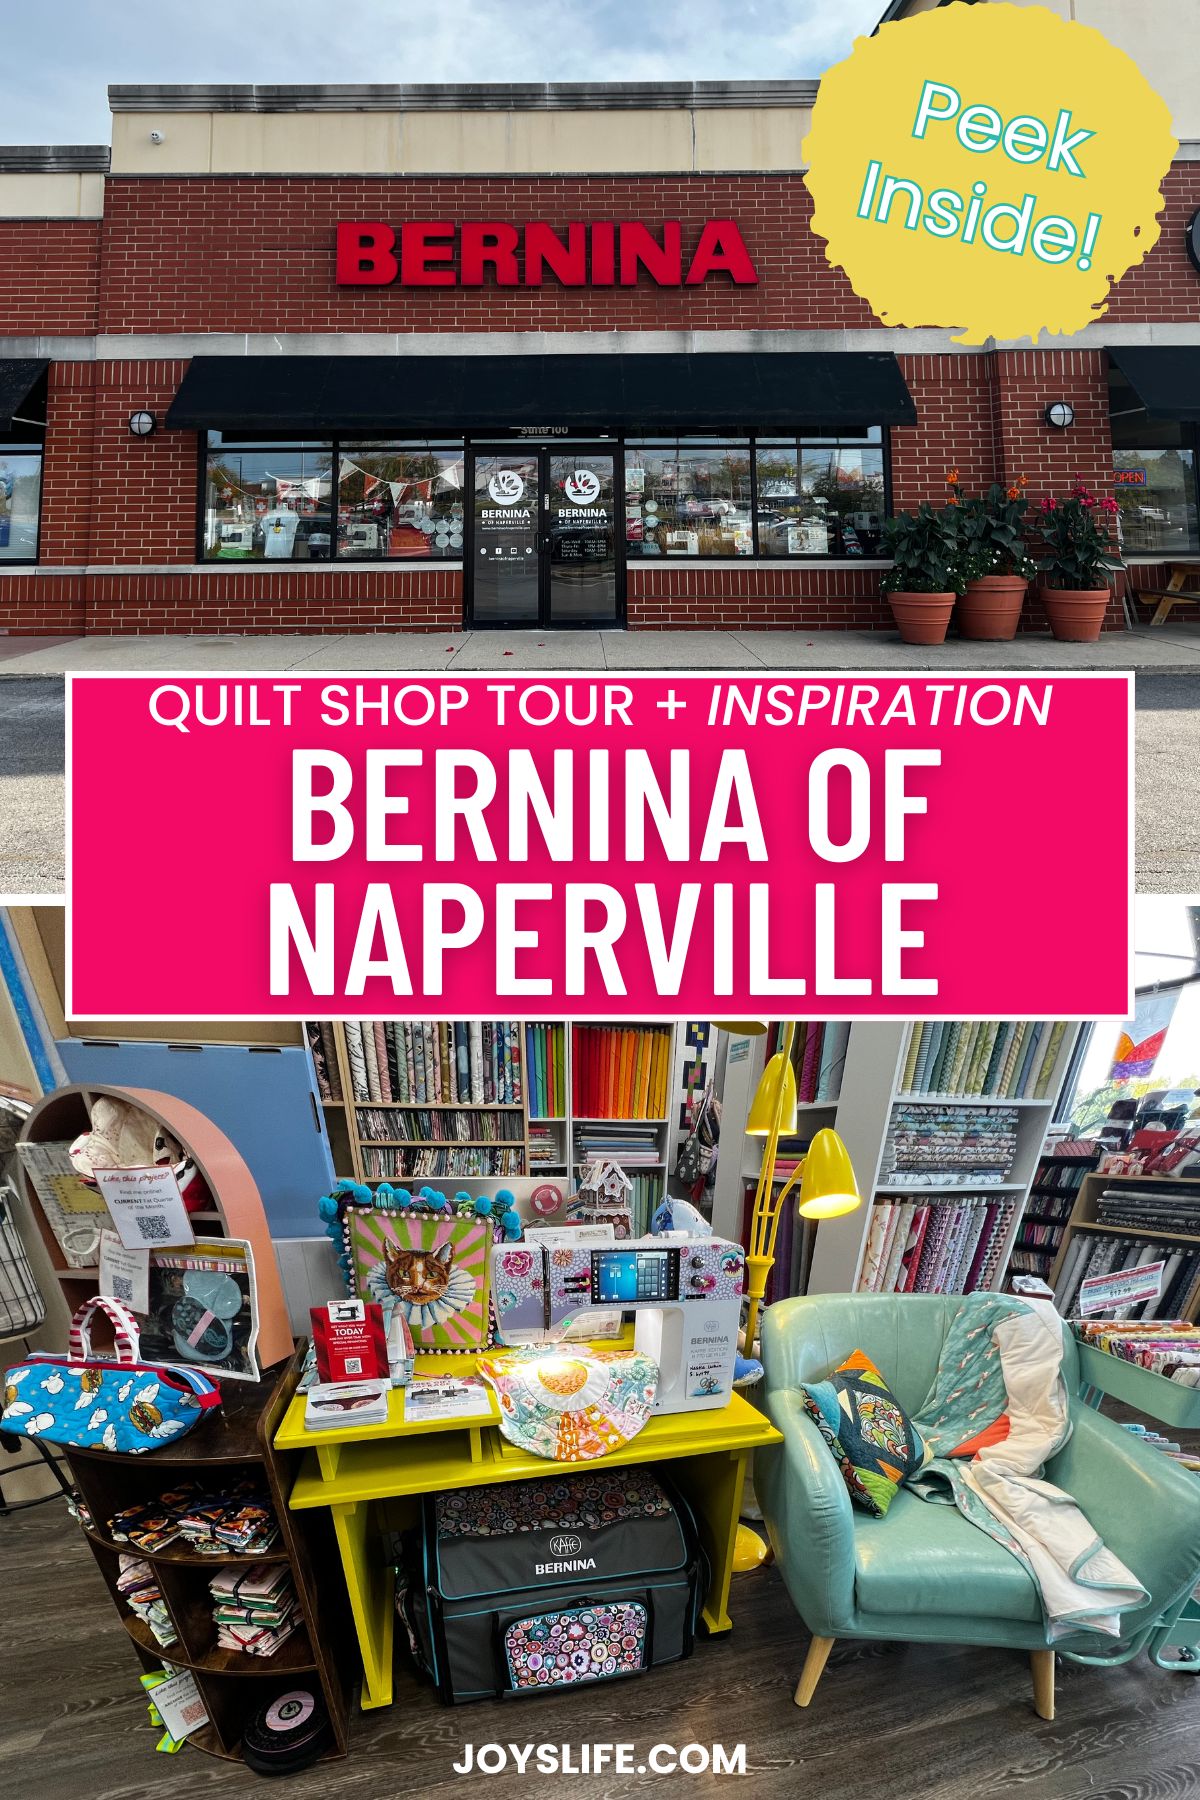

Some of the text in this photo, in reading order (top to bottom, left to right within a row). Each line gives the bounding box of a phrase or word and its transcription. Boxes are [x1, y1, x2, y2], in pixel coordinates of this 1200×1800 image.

[336, 219, 760, 287] BERNINA
[1113, 472, 1144, 483] OPEN
[482, 509, 530, 518] BERNINA
[558, 508, 607, 517] BERNINA
[139, 1172, 169, 1184] project?
[334, 1328, 364, 1336] TODAY
[691, 1336, 729, 1344] BERNINA
[535, 1558, 597, 1575] BERNINA
